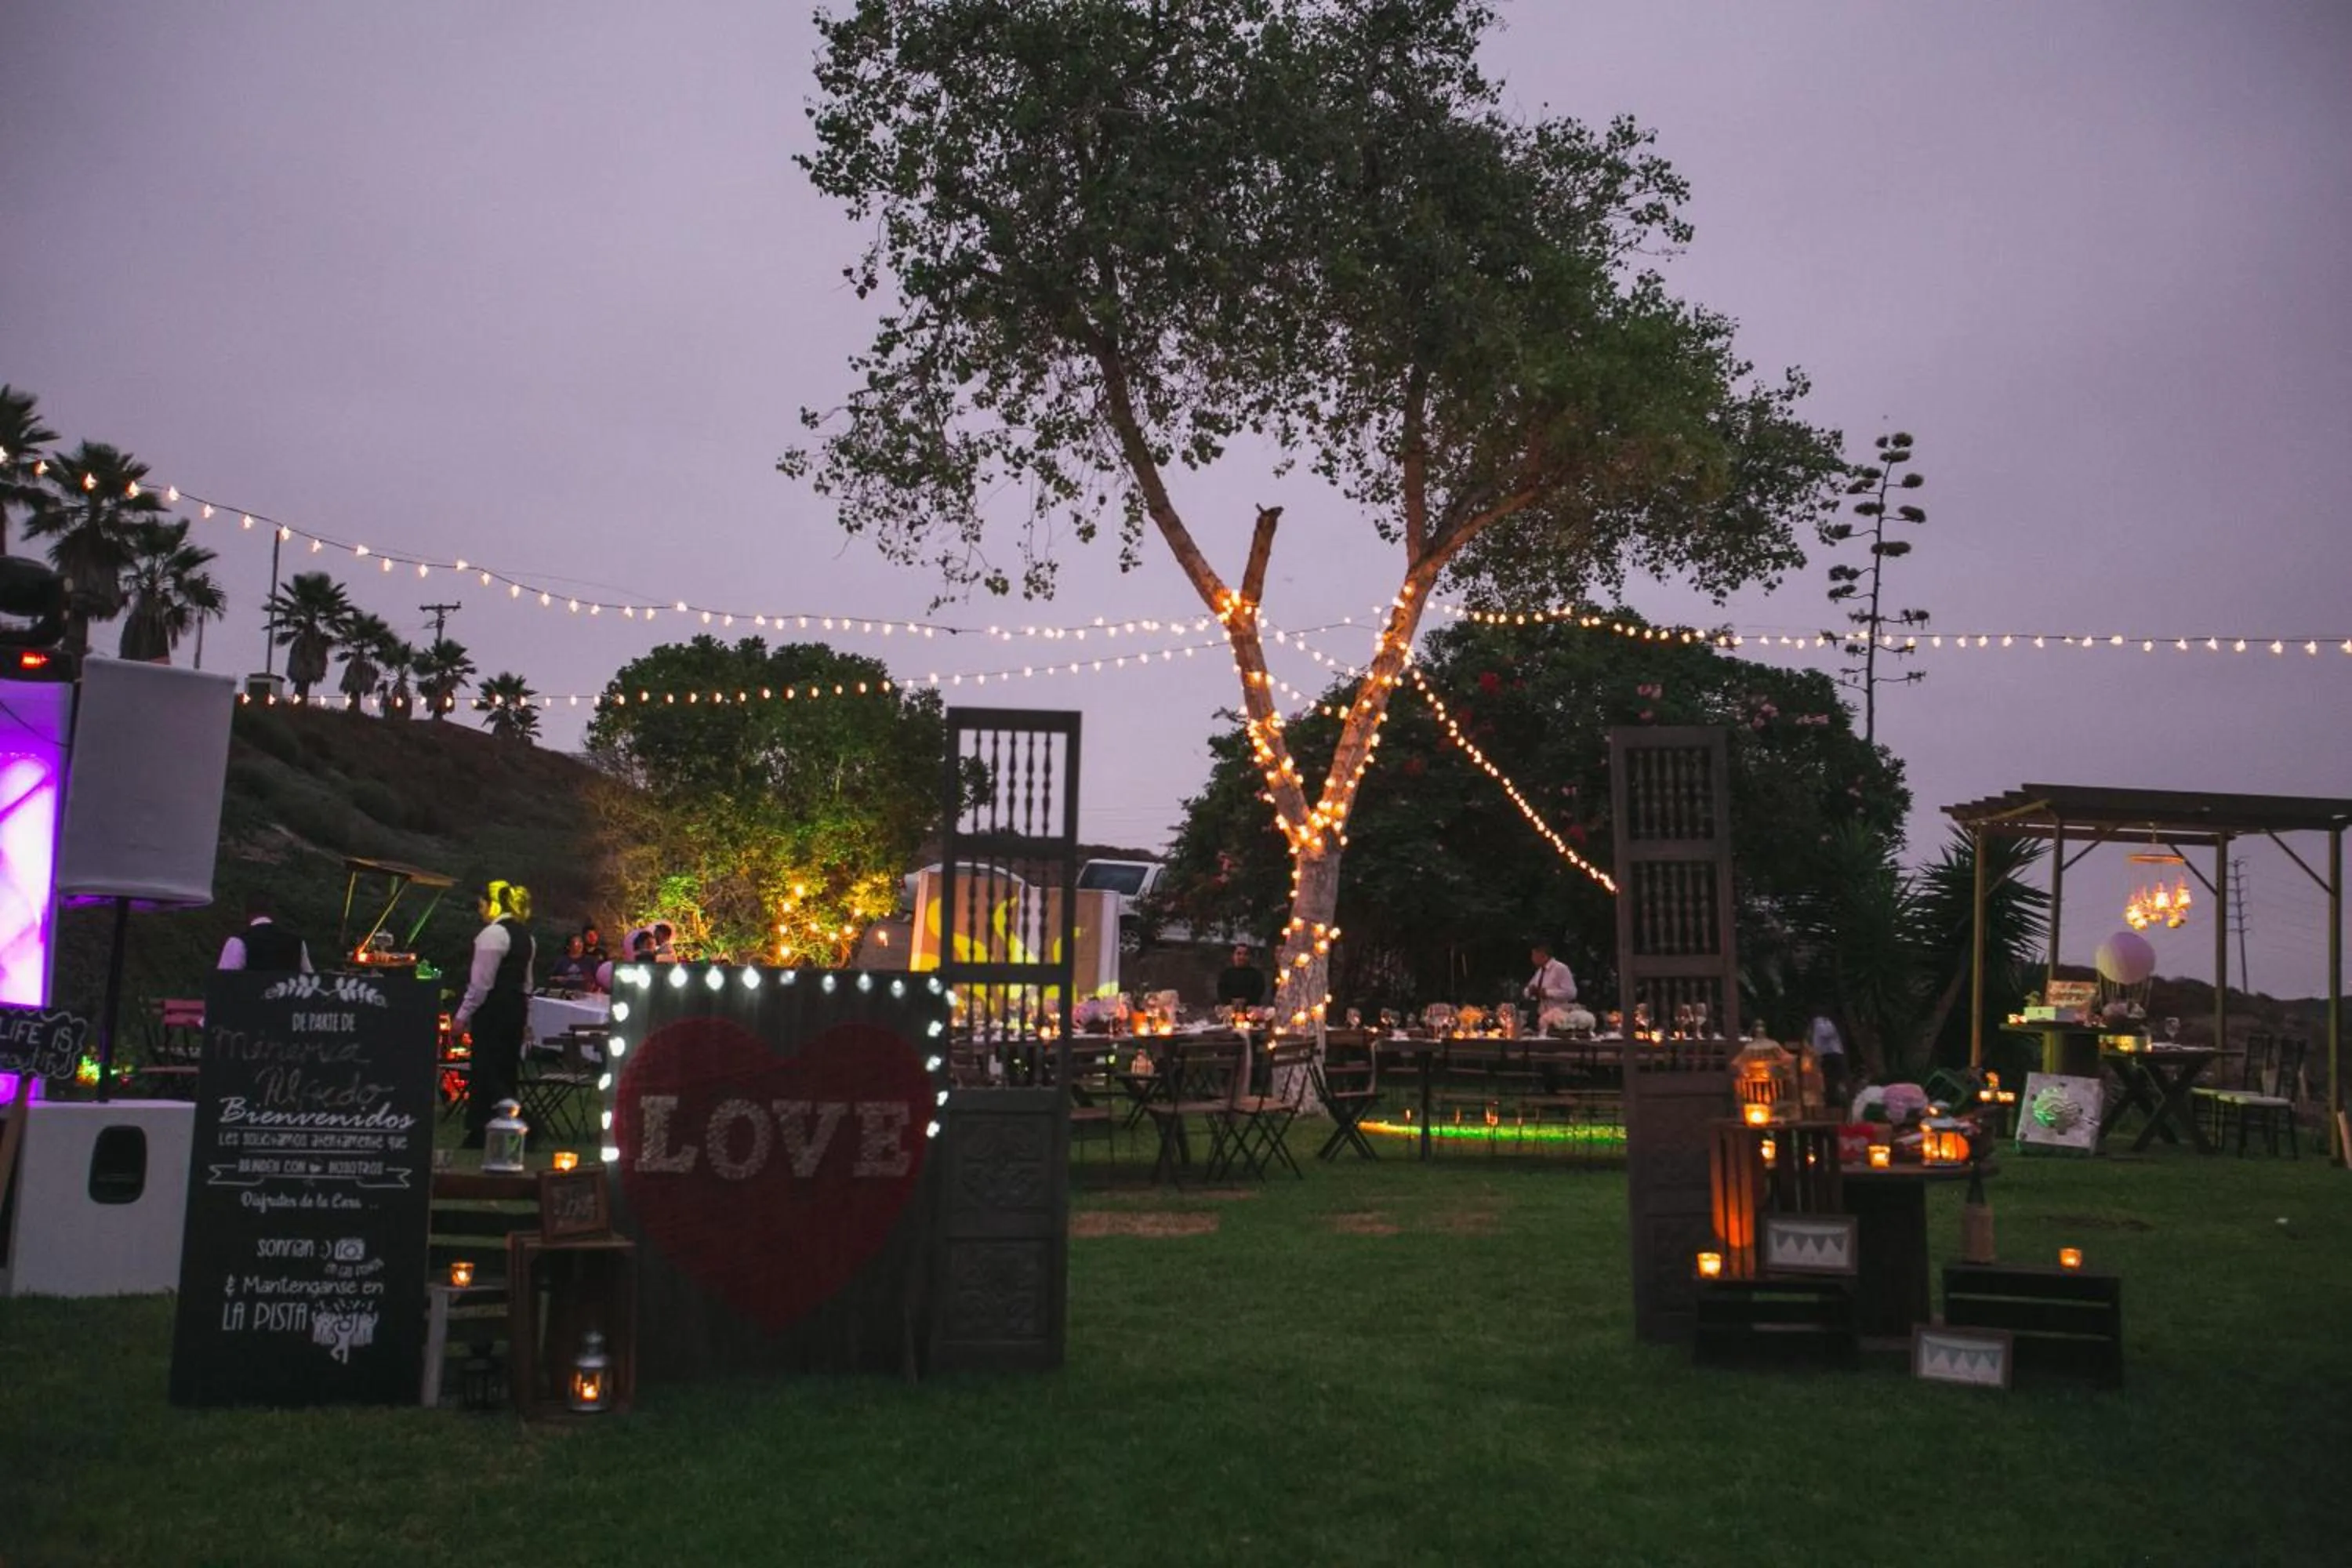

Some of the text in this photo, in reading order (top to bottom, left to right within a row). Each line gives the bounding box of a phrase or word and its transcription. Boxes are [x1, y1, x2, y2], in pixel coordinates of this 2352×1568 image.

[292, 1012, 307, 1032] DE
[341, 1013, 356, 1033] DE
[51, 1026, 74, 1053] IS
[219, 1096, 416, 1130] Bienvenidos
[634, 1095, 911, 1179] LOVE
[283, 1160, 307, 1174] CON
[362, 1279, 385, 1294] en
[222, 1300, 308, 1330] LA PISTA
